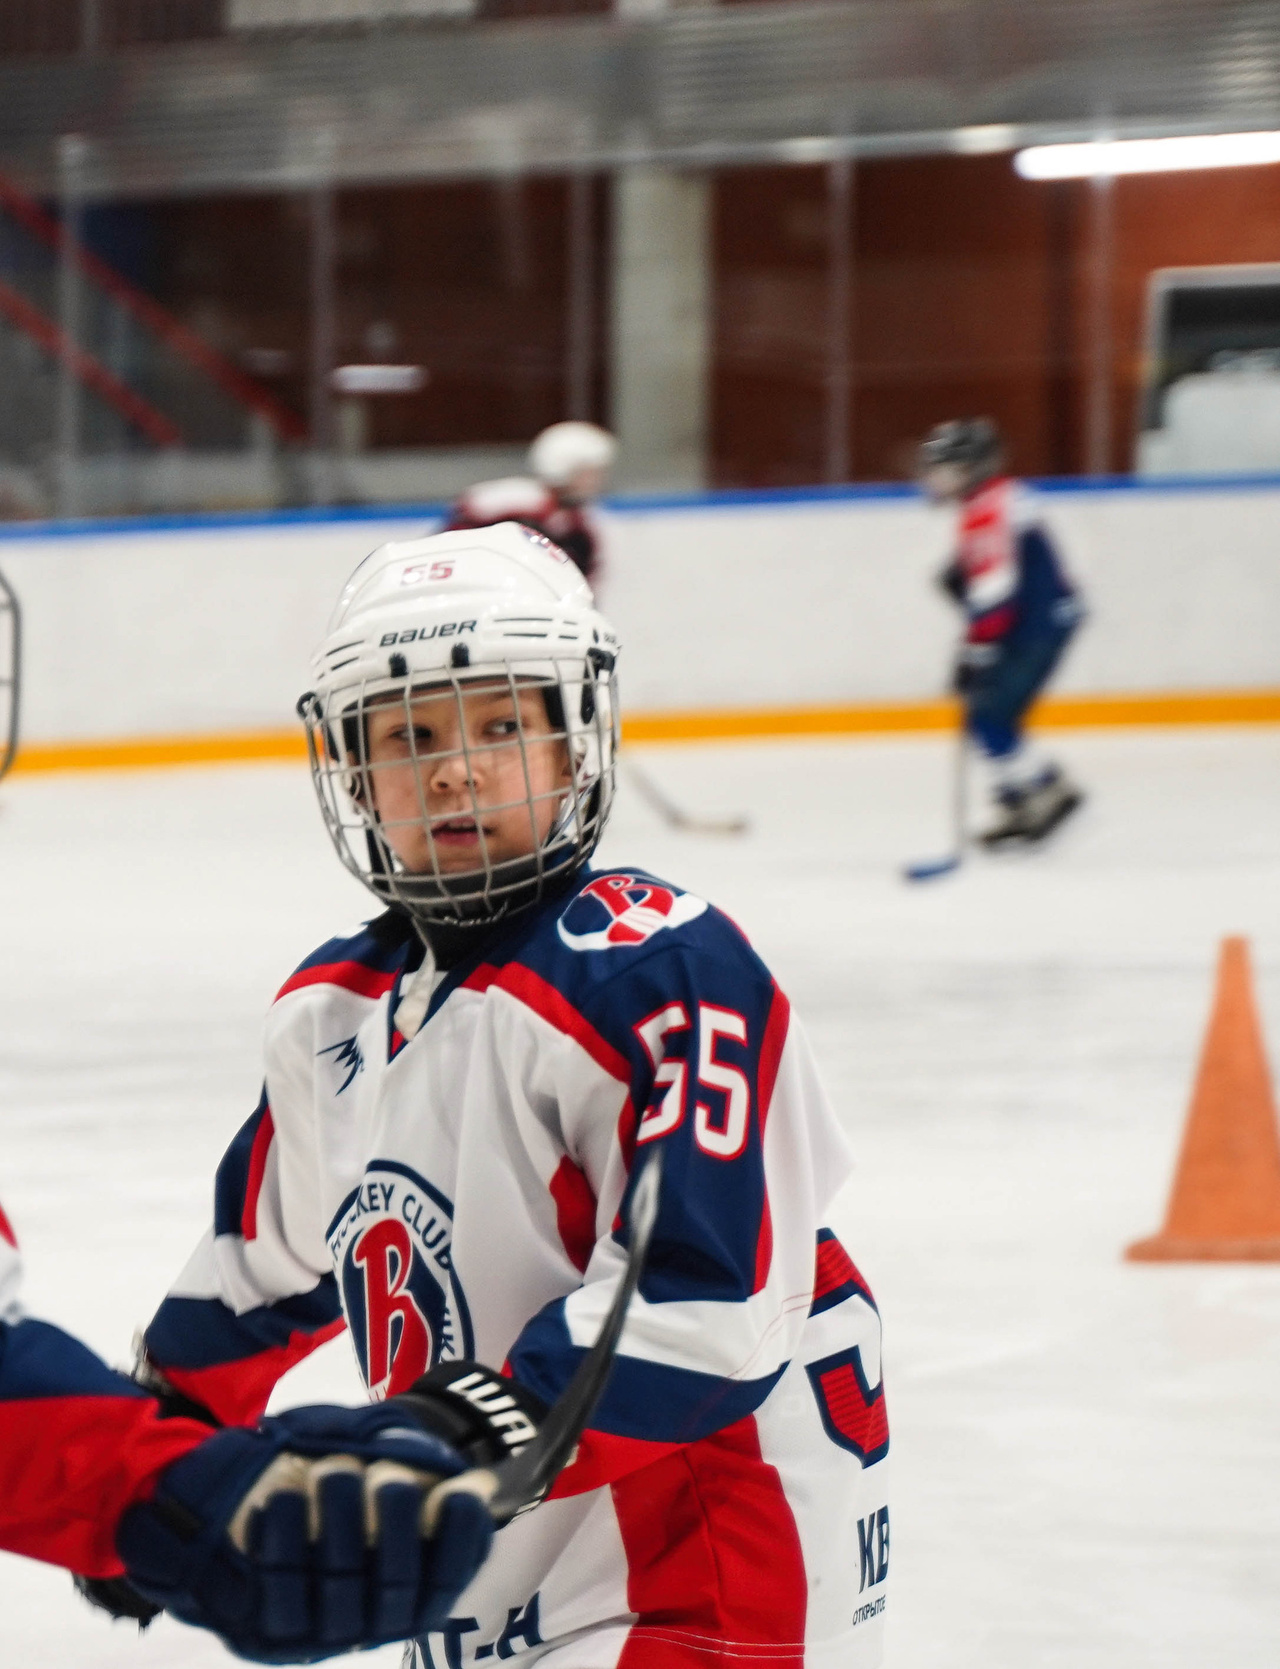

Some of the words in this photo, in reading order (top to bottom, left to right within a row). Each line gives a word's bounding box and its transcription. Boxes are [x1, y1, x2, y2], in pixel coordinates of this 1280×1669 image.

[400, 559, 456, 587] 55
[631, 1000, 751, 1162] 55
[446, 1371, 539, 1458] WA
